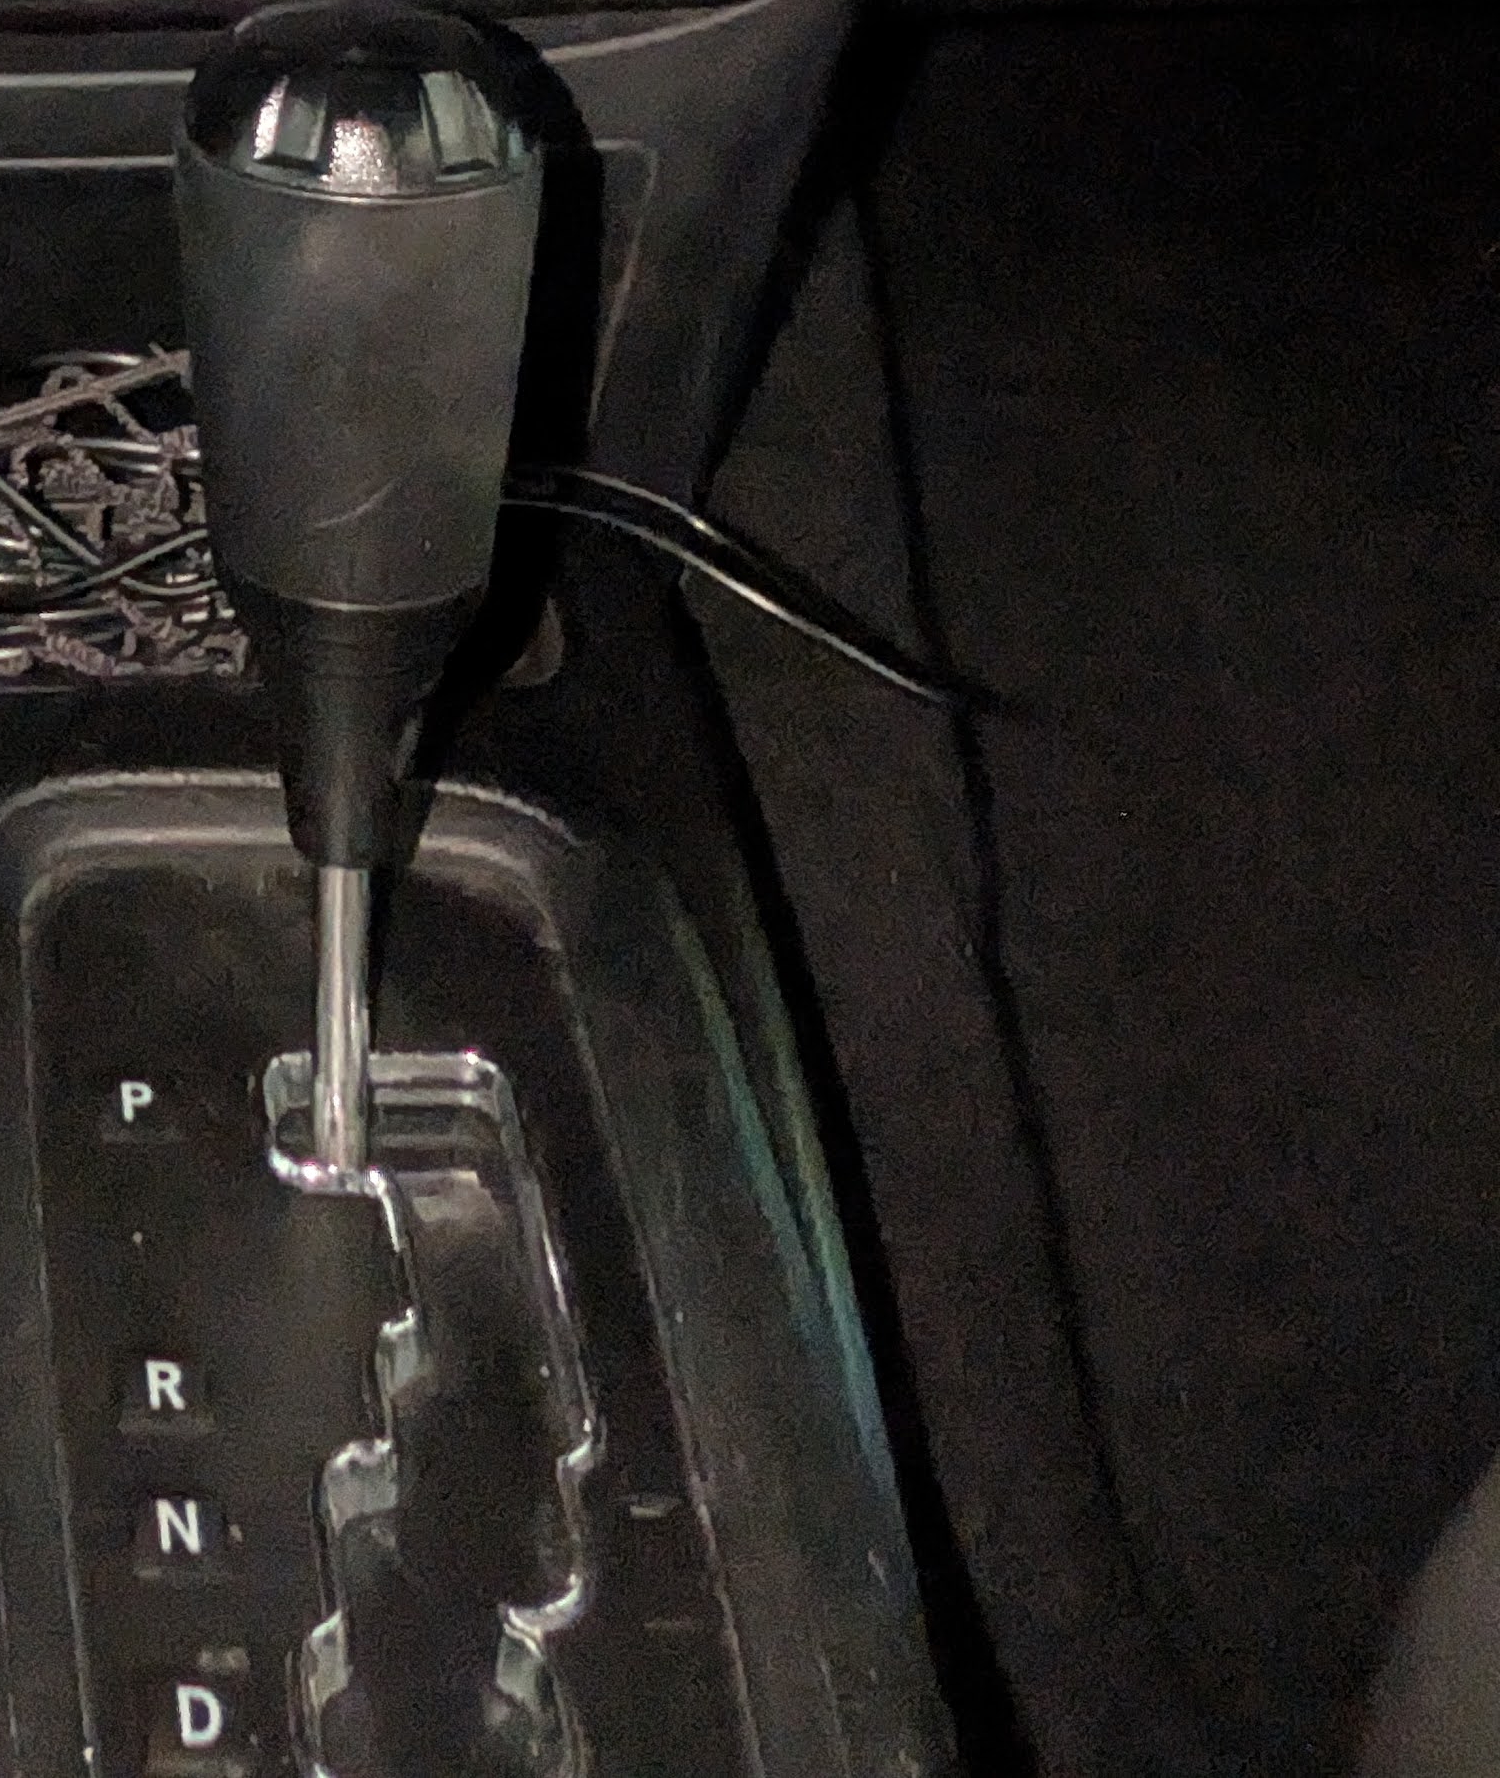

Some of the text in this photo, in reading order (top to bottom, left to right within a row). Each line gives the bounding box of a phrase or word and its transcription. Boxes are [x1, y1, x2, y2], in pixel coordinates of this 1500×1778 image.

[119, 1080, 155, 1123] P
[145, 1359, 186, 1411] R
[155, 1498, 202, 1555] N
[175, 1684, 223, 1747] D
